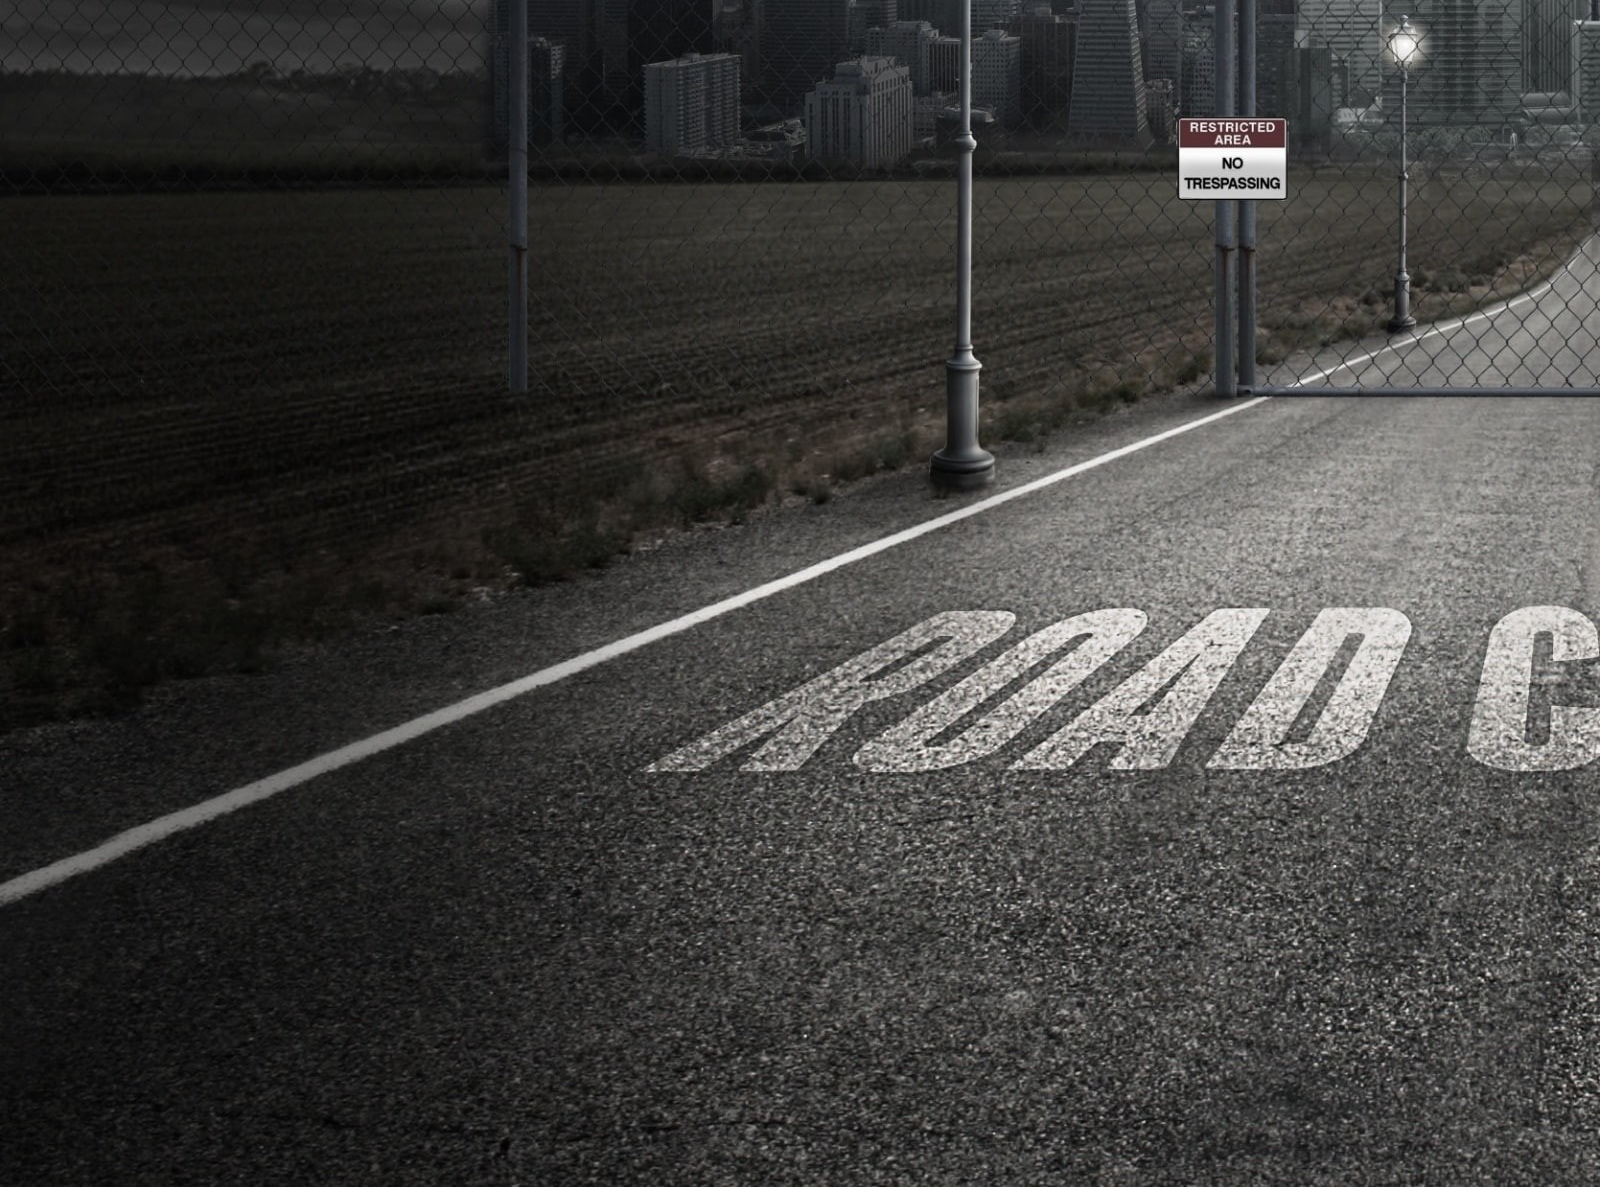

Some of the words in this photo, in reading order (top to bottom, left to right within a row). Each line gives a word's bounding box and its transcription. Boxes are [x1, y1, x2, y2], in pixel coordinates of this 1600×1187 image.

[1190, 122, 1276, 133] RESTRICTED
[1214, 134, 1252, 145] AREA
[1222, 157, 1244, 169] NO
[1184, 177, 1281, 190] TRESPASSING
[640, 607, 1412, 773] ROAD
